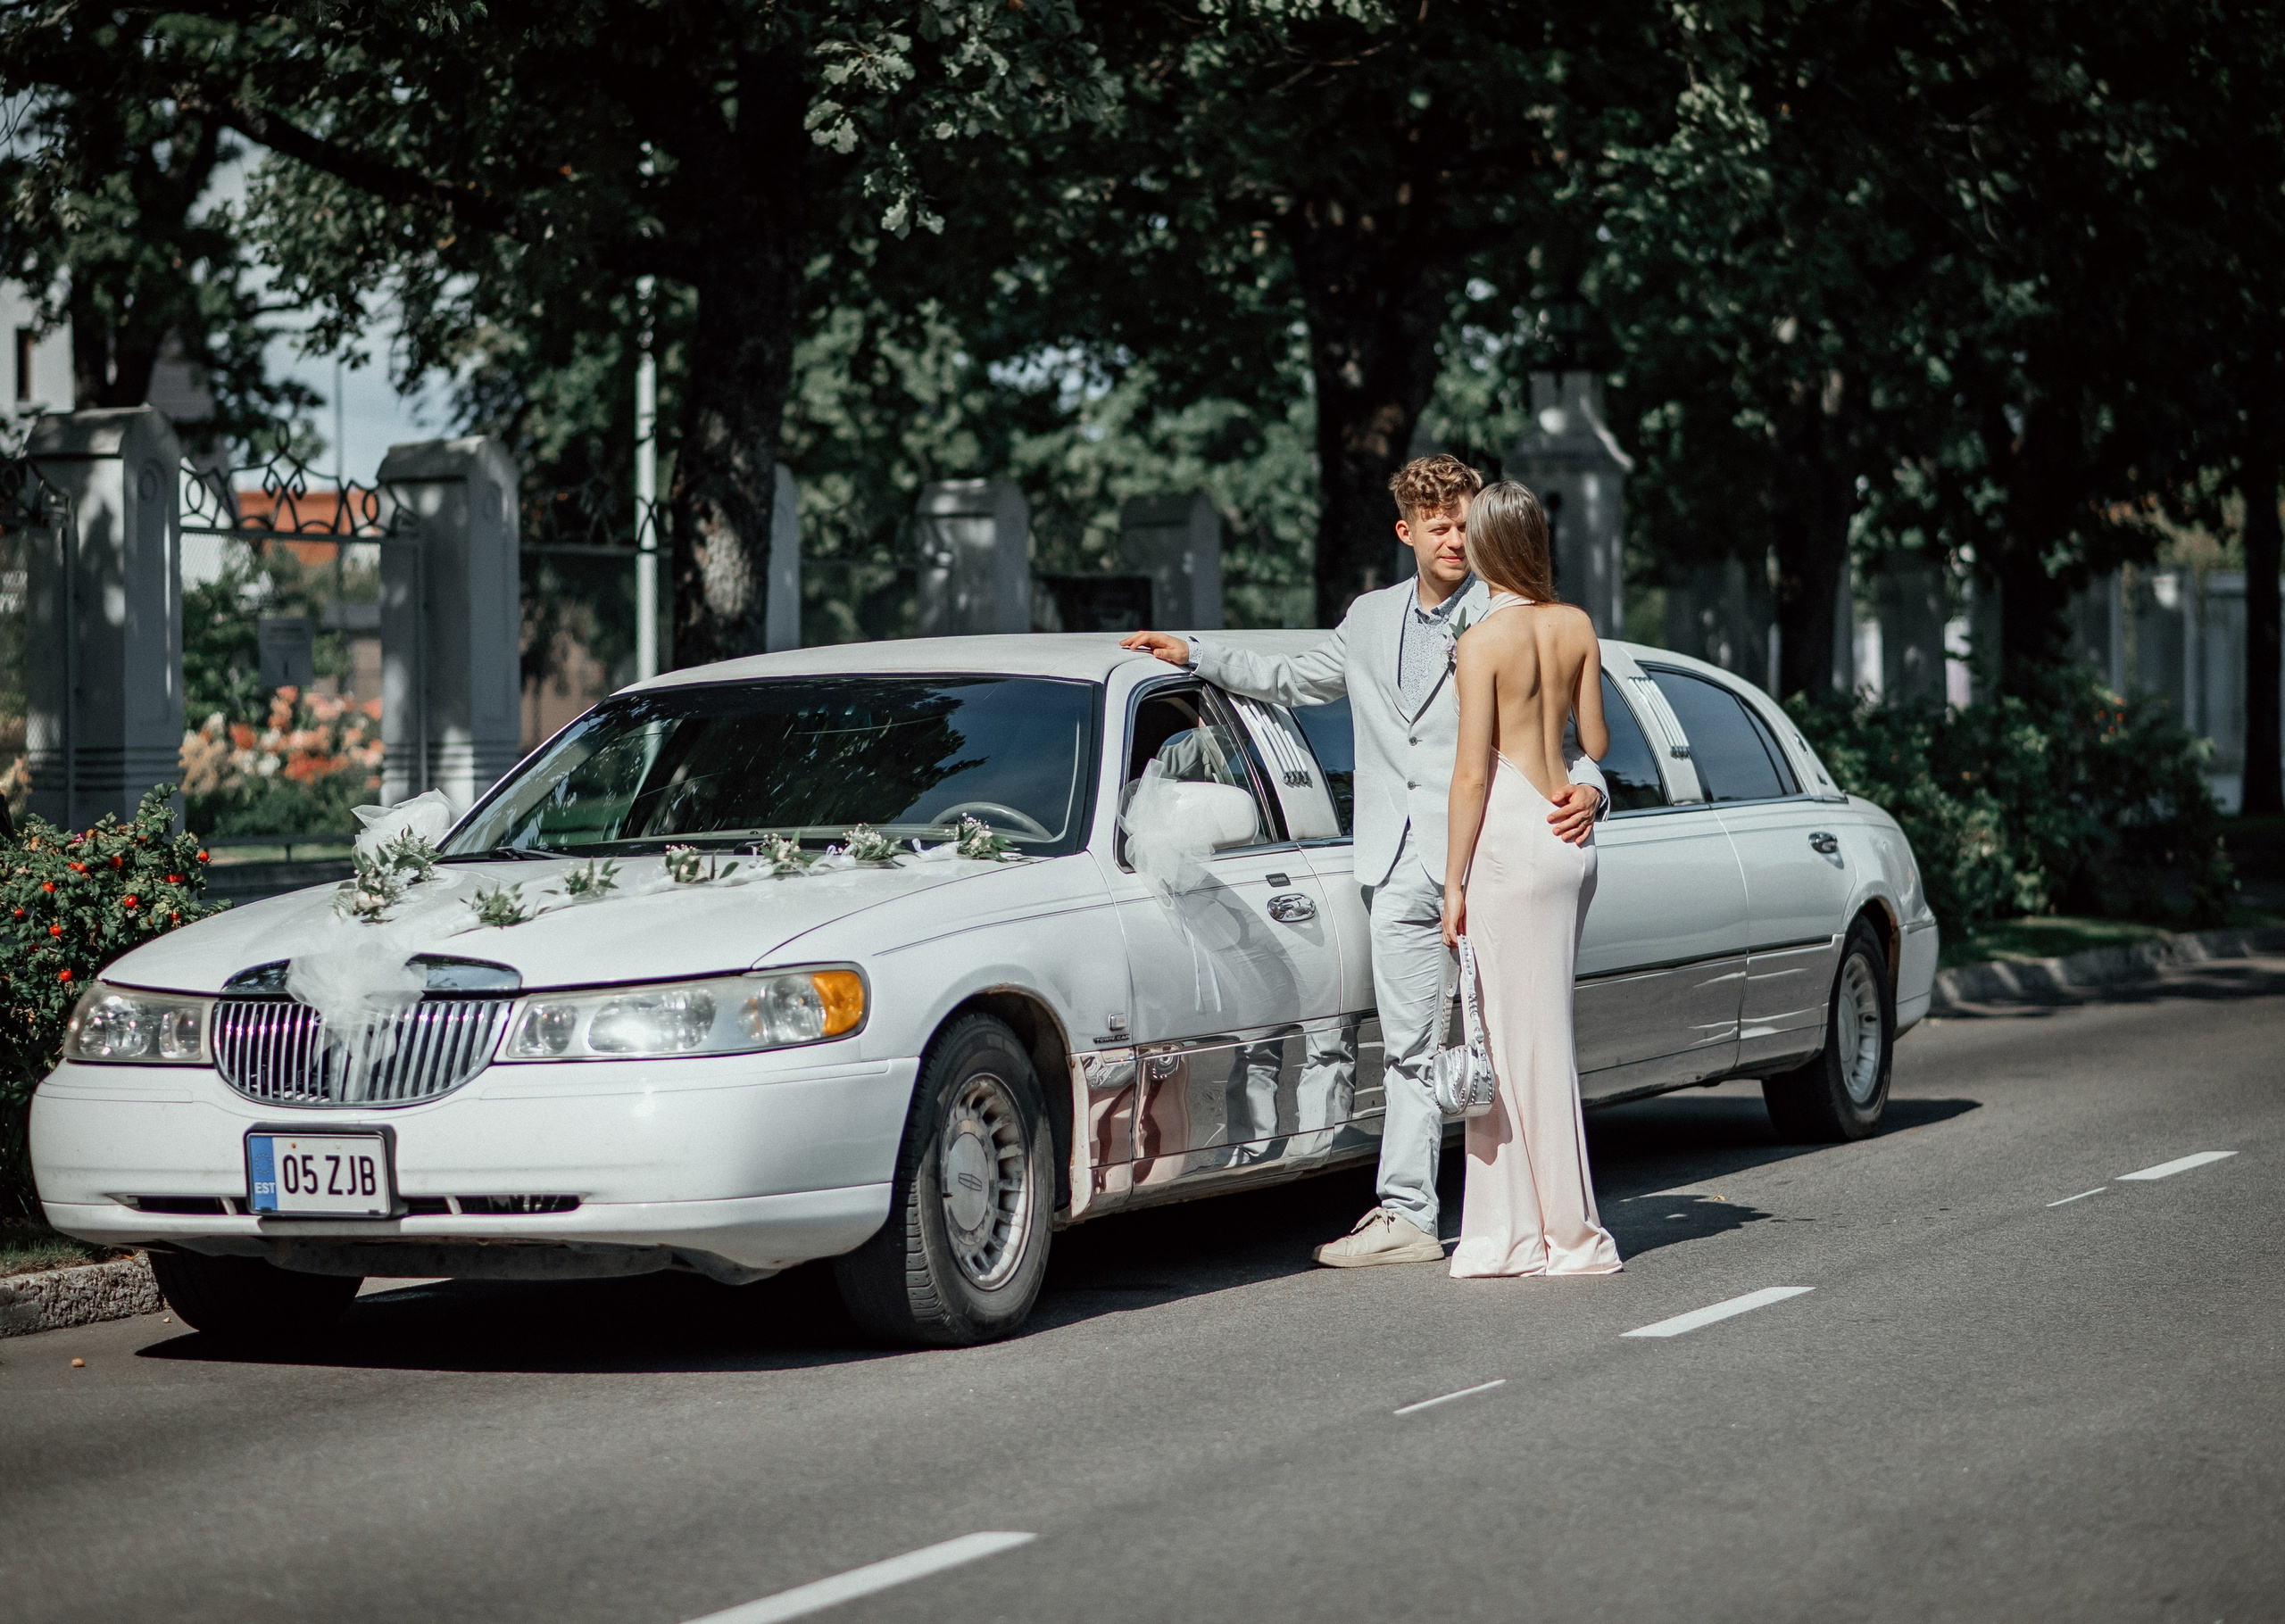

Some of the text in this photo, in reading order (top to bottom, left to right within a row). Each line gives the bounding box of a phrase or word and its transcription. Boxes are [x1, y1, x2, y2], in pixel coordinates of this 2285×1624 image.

[254, 1182, 276, 1194] EST
[282, 1154, 376, 1196] 05 ZJB
